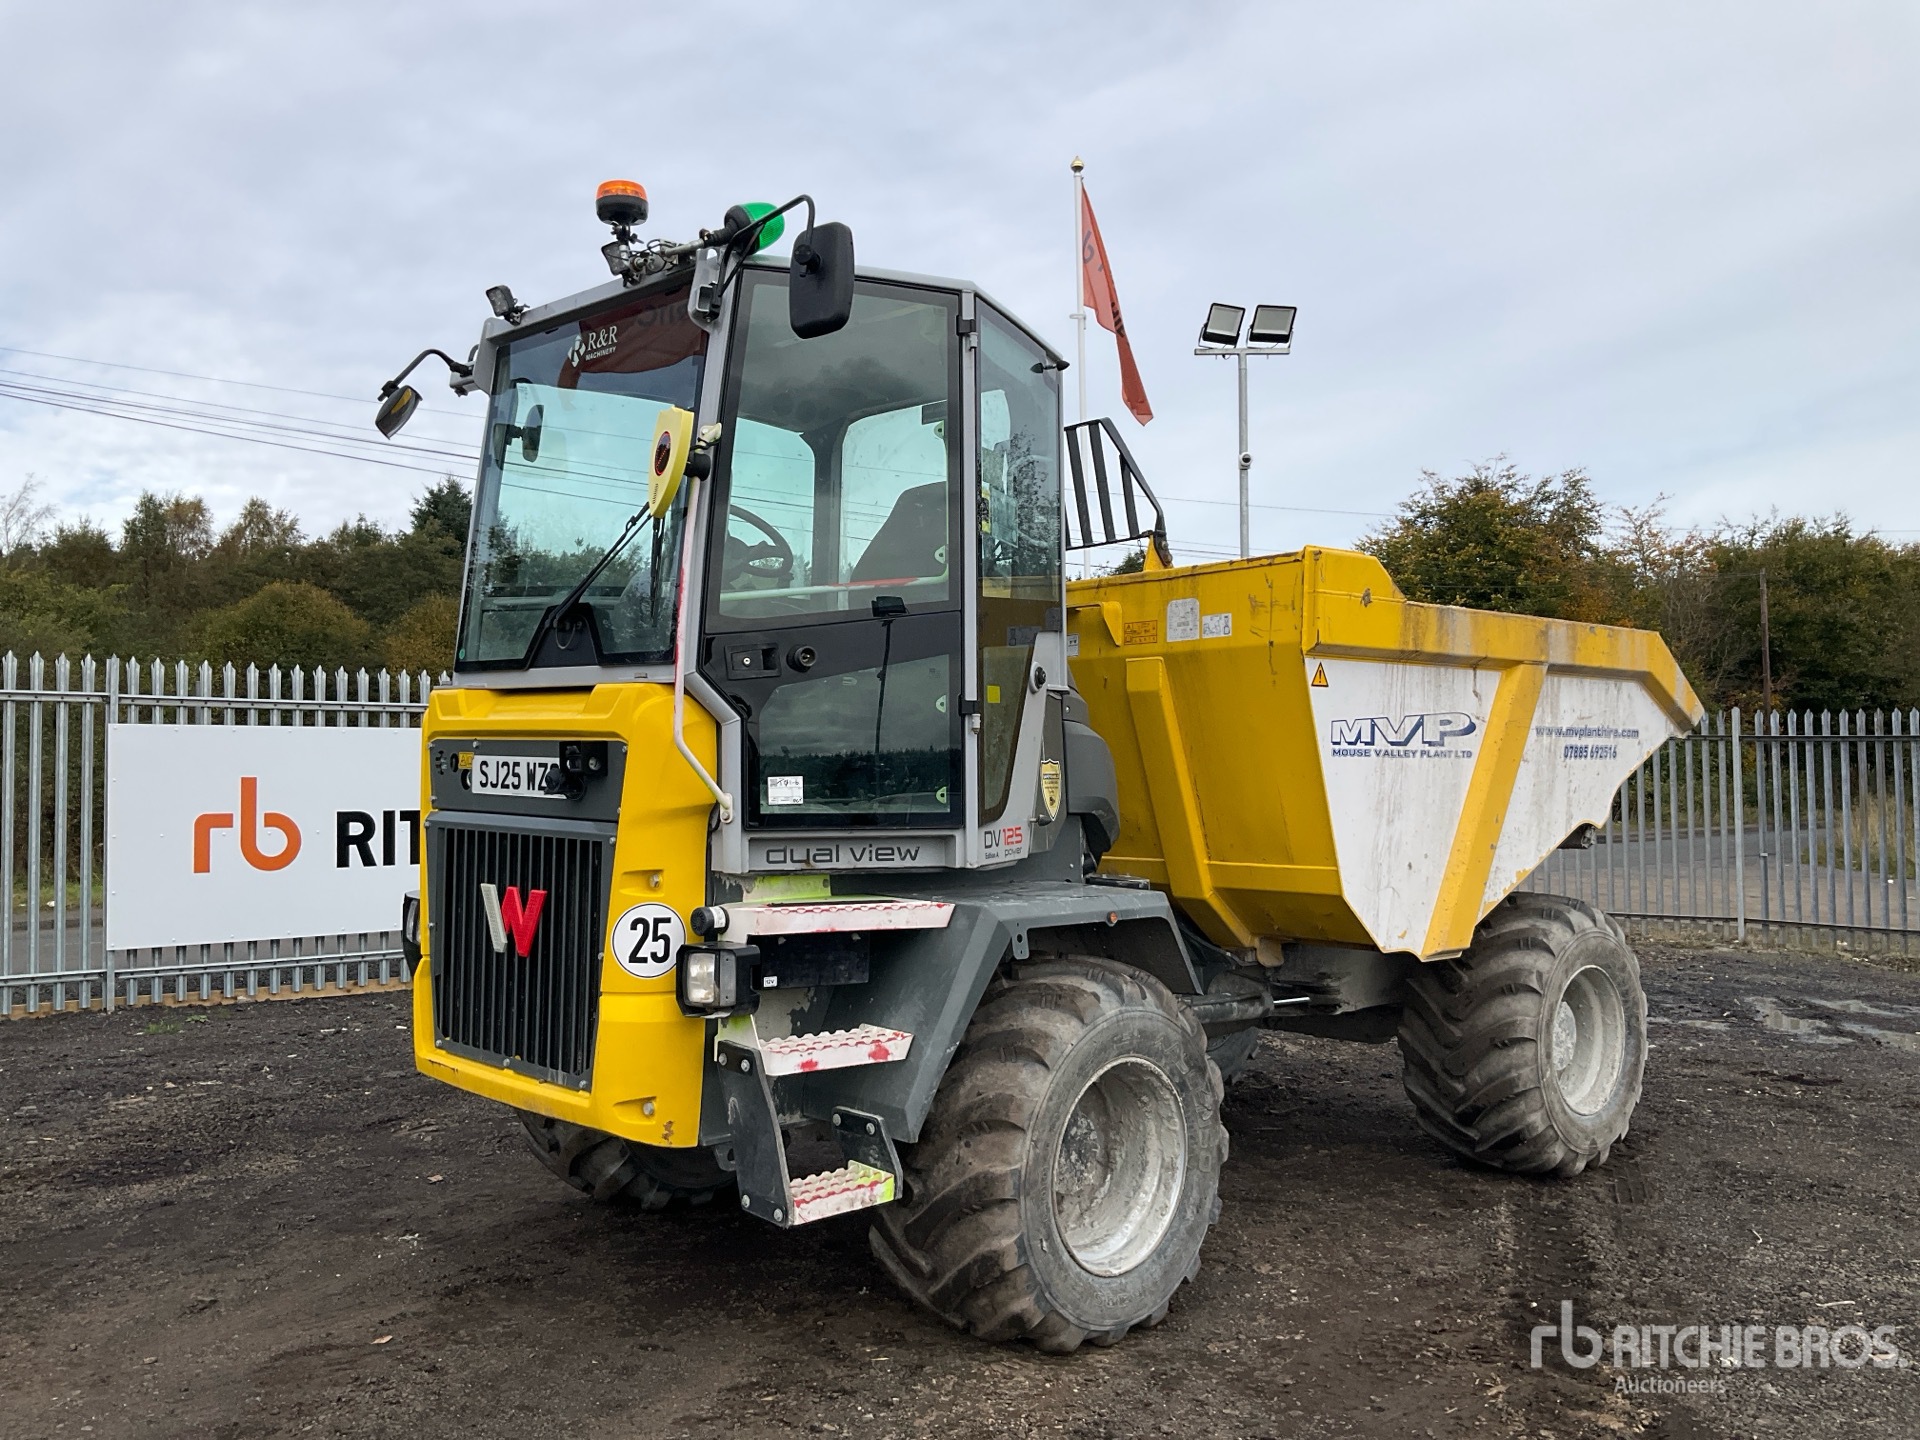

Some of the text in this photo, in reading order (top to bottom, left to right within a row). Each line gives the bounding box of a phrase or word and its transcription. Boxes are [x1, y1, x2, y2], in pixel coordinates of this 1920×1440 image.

[587, 325, 618, 351] R&R
[585, 346, 616, 361] MACHINERY
[1331, 712, 1476, 746] MVP
[1535, 725, 1639, 740] www.mvplanthire.com
[1332, 748, 1473, 759] MOUSE VALLEY PLANT LTD
[1563, 743, 1617, 760] 07885 692516
[479, 760, 560, 791] SJ25 WZ
[193, 777, 421, 873] rb RIT
[766, 843, 920, 864] dual view
[1004, 847, 1022, 858] power
[628, 916, 672, 964] 25
